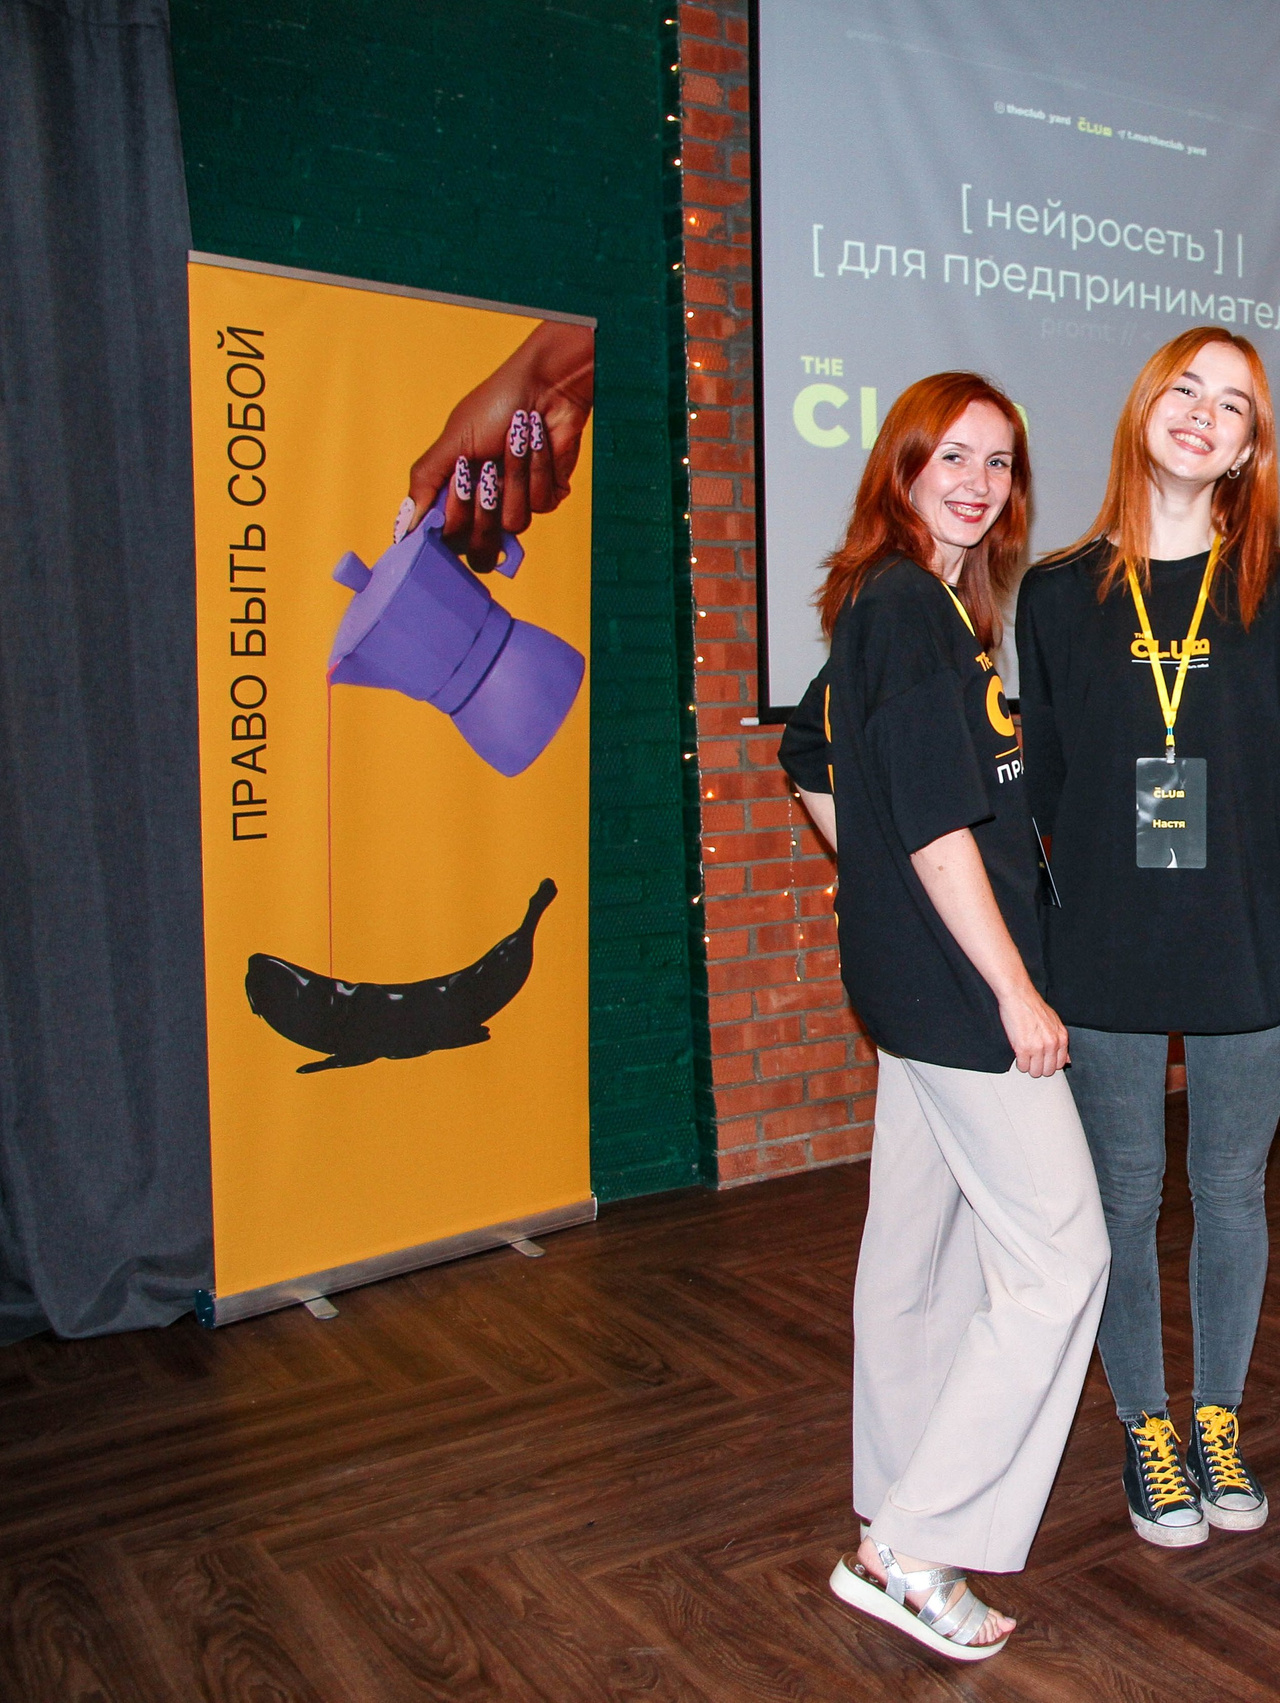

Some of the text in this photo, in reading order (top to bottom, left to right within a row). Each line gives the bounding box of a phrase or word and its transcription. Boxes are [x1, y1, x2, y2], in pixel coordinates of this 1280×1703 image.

[987, 198, 1205, 262] нейросеть
[838, 240, 927, 280] для
[801, 355, 844, 377] THE
[217, 326, 268, 841] ПРАВО БЫТЬ СОБОЙ
[1152, 819, 1186, 828] Настя
